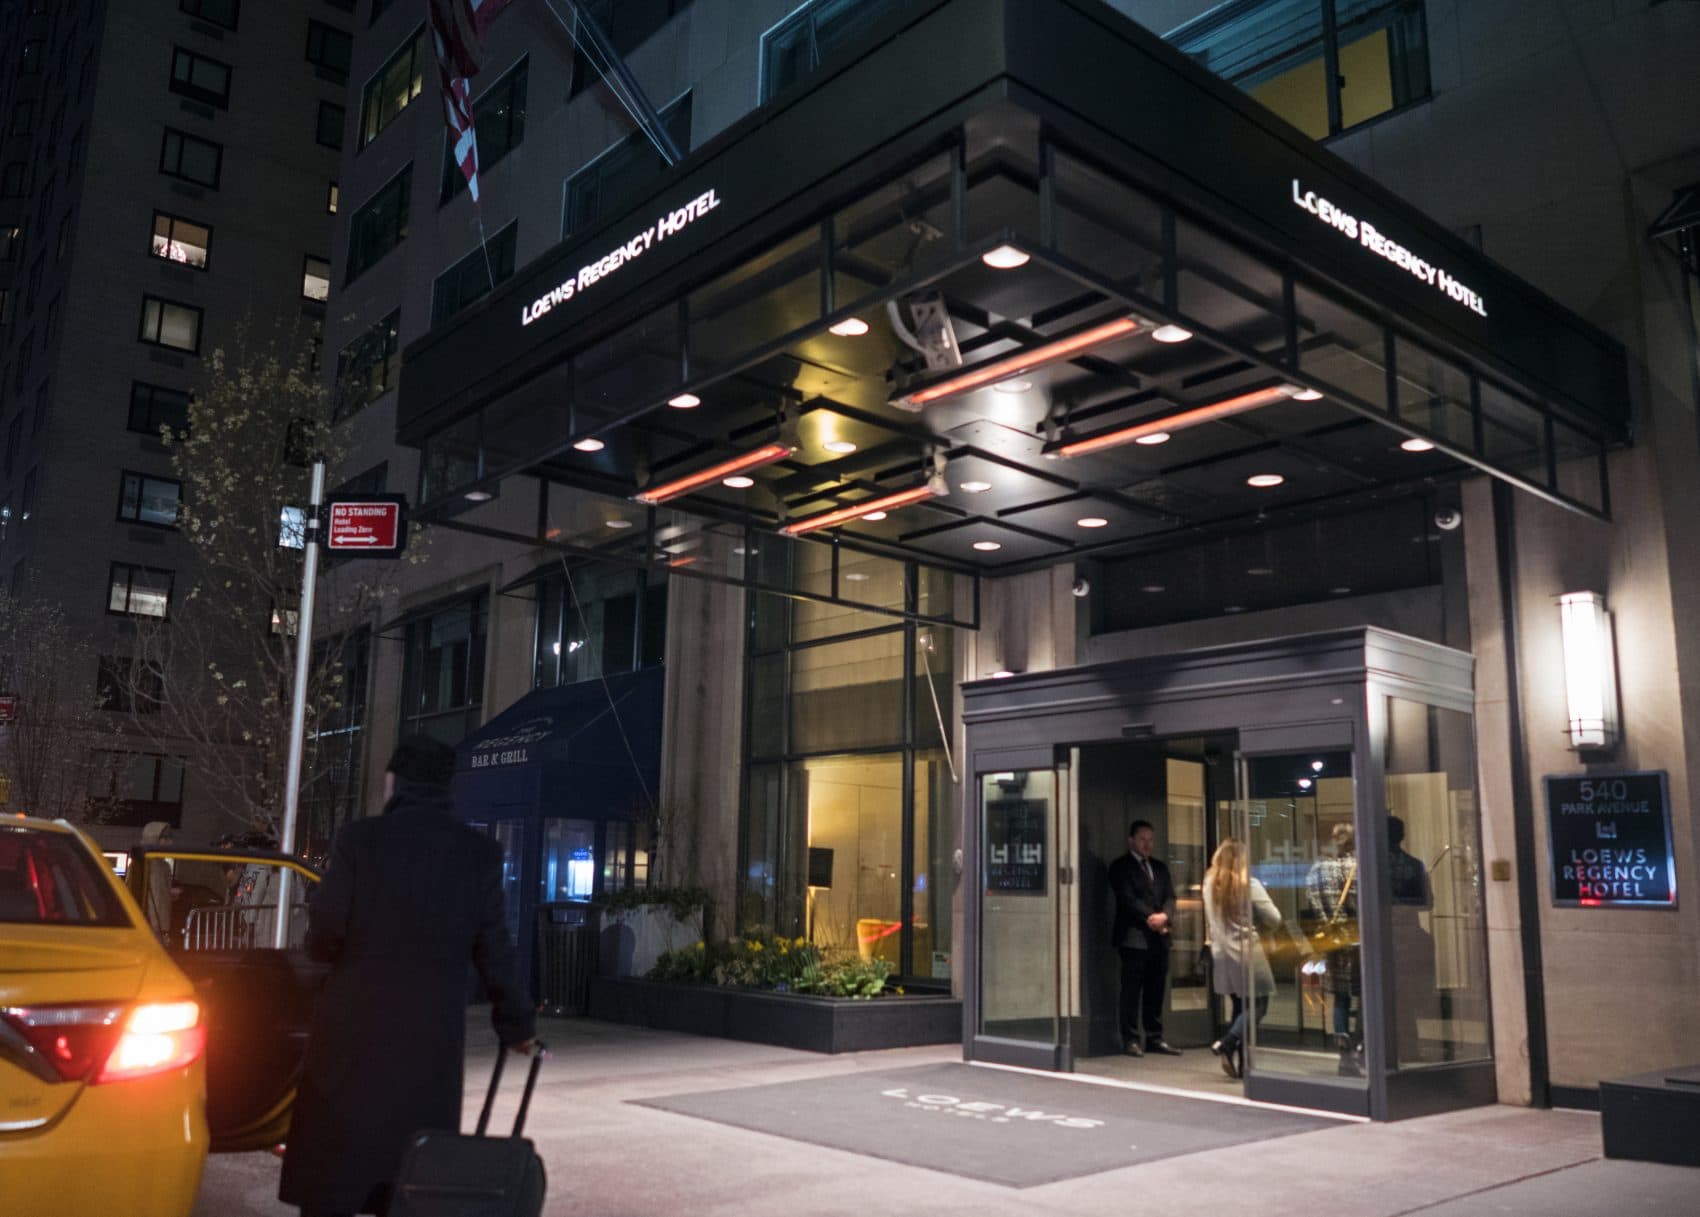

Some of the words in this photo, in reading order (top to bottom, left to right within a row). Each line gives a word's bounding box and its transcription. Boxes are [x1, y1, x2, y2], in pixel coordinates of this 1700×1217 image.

[1292, 178, 1359, 239] LOEWS
[1359, 220, 1438, 285] REGENCY
[1437, 268, 1488, 317] HOTEL
[521, 278, 577, 326] LOEWS
[577, 226, 655, 292] REGENCY
[657, 188, 721, 241] HOTEL
[335, 508, 347, 516] NO
[348, 508, 387, 516] STANDING
[472, 754, 489, 768] BAR
[501, 749, 528, 764] GRILL
[1580, 779, 1628, 801] 540
[1561, 802, 1594, 815] PARK
[1597, 800, 1649, 814] AVENUE
[1571, 848, 1647, 864] LOEWS
[1563, 865, 1656, 881] REGENCY
[1579, 882, 1645, 897] HOTEL
